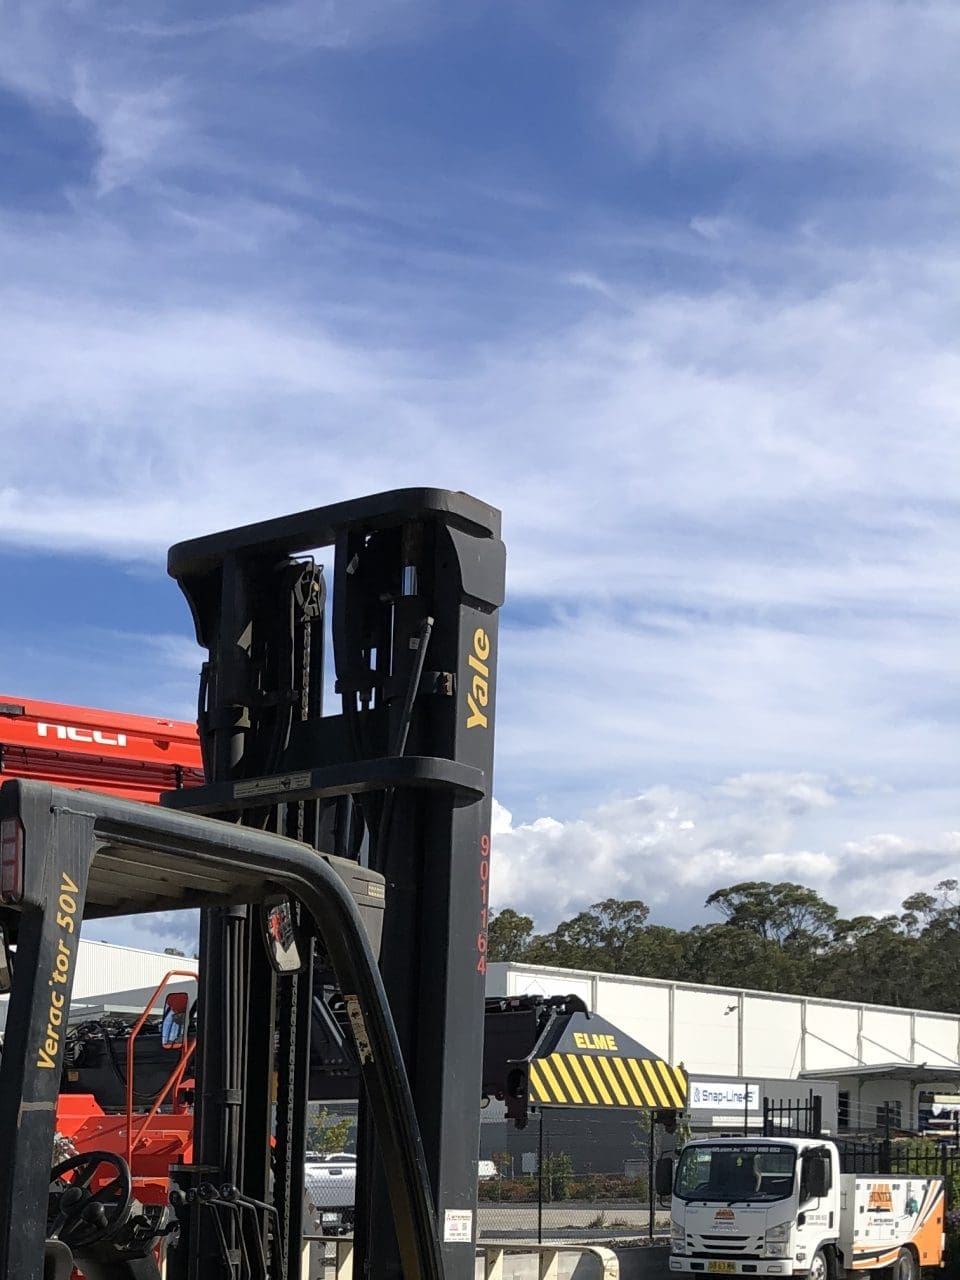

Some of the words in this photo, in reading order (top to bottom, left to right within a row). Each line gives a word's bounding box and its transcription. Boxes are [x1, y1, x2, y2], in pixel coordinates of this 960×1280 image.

[467, 628, 490, 729] Yale
[477, 834, 489, 976] 901164
[36, 938, 71, 1069] Veractor
[56, 872, 79, 934] 50V
[573, 1032, 618, 1051] ELME
